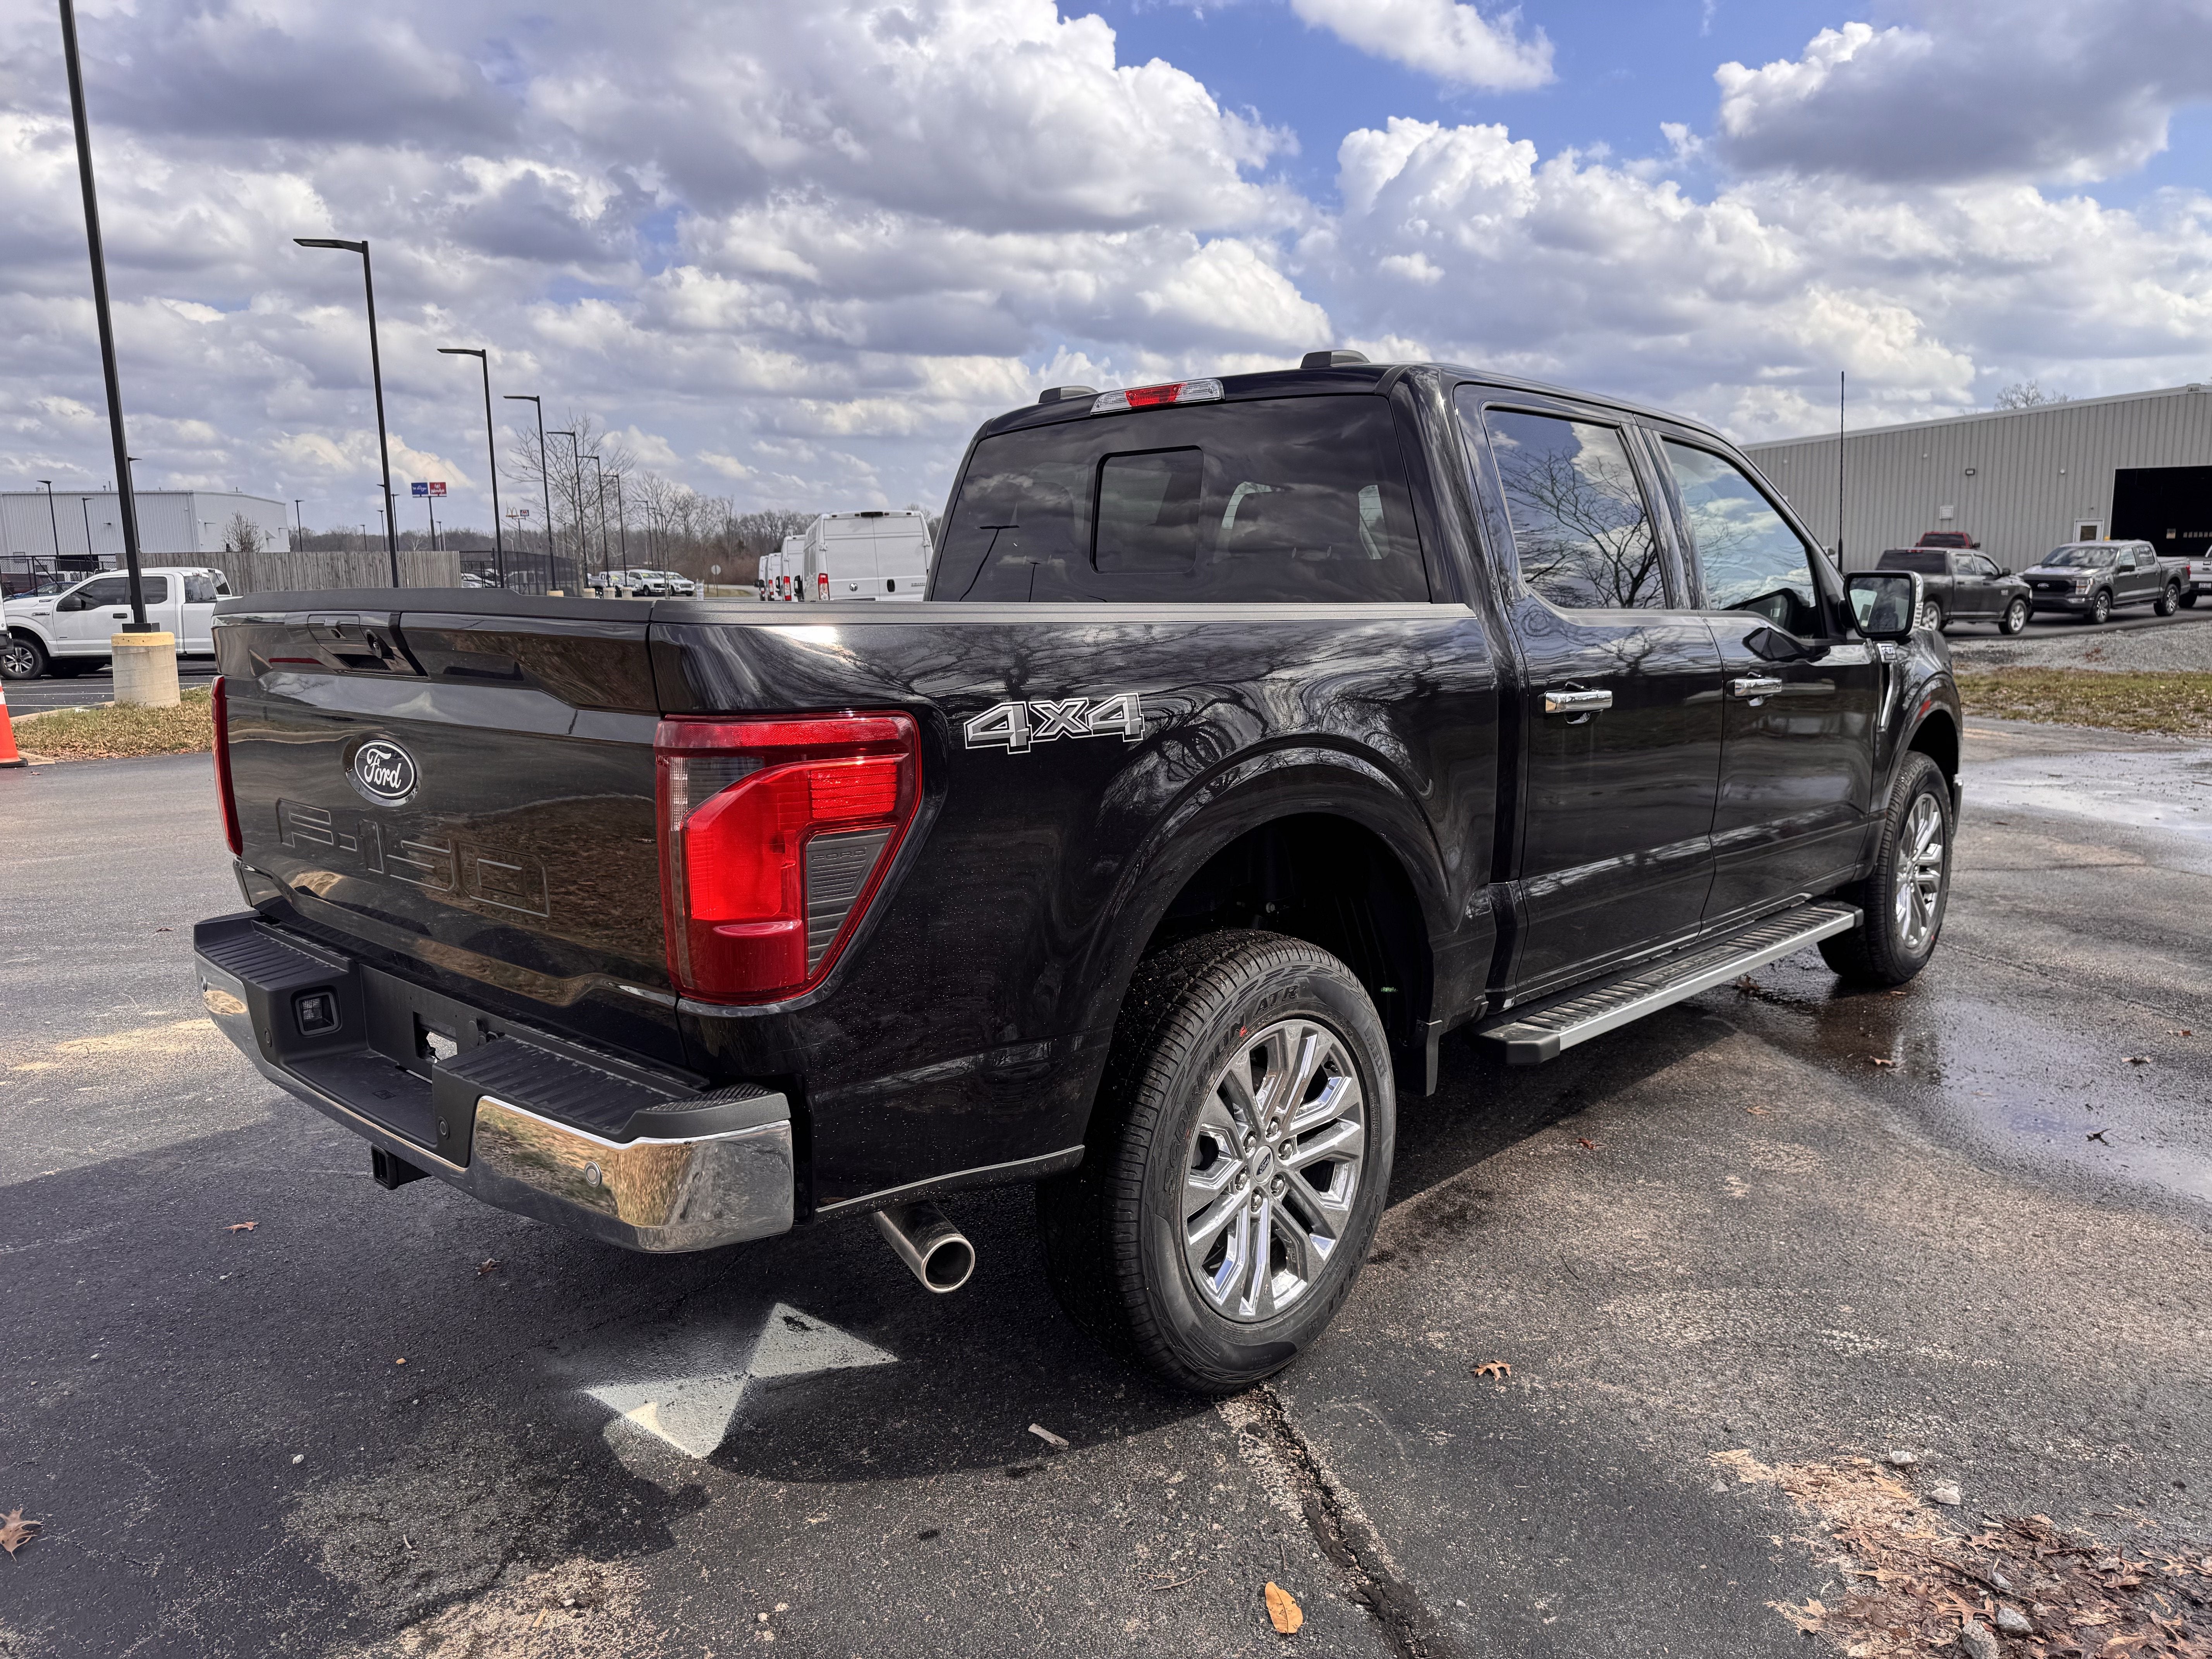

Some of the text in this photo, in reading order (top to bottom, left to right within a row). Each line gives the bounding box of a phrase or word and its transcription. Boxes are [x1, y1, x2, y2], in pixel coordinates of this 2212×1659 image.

[364, 748, 402, 789] Ford
[275, 797, 550, 918] F-150
[811, 850, 867, 862] FORD
[1253, 985, 1300, 1018] ATR
[1259, 1156, 1269, 1173] Ford
